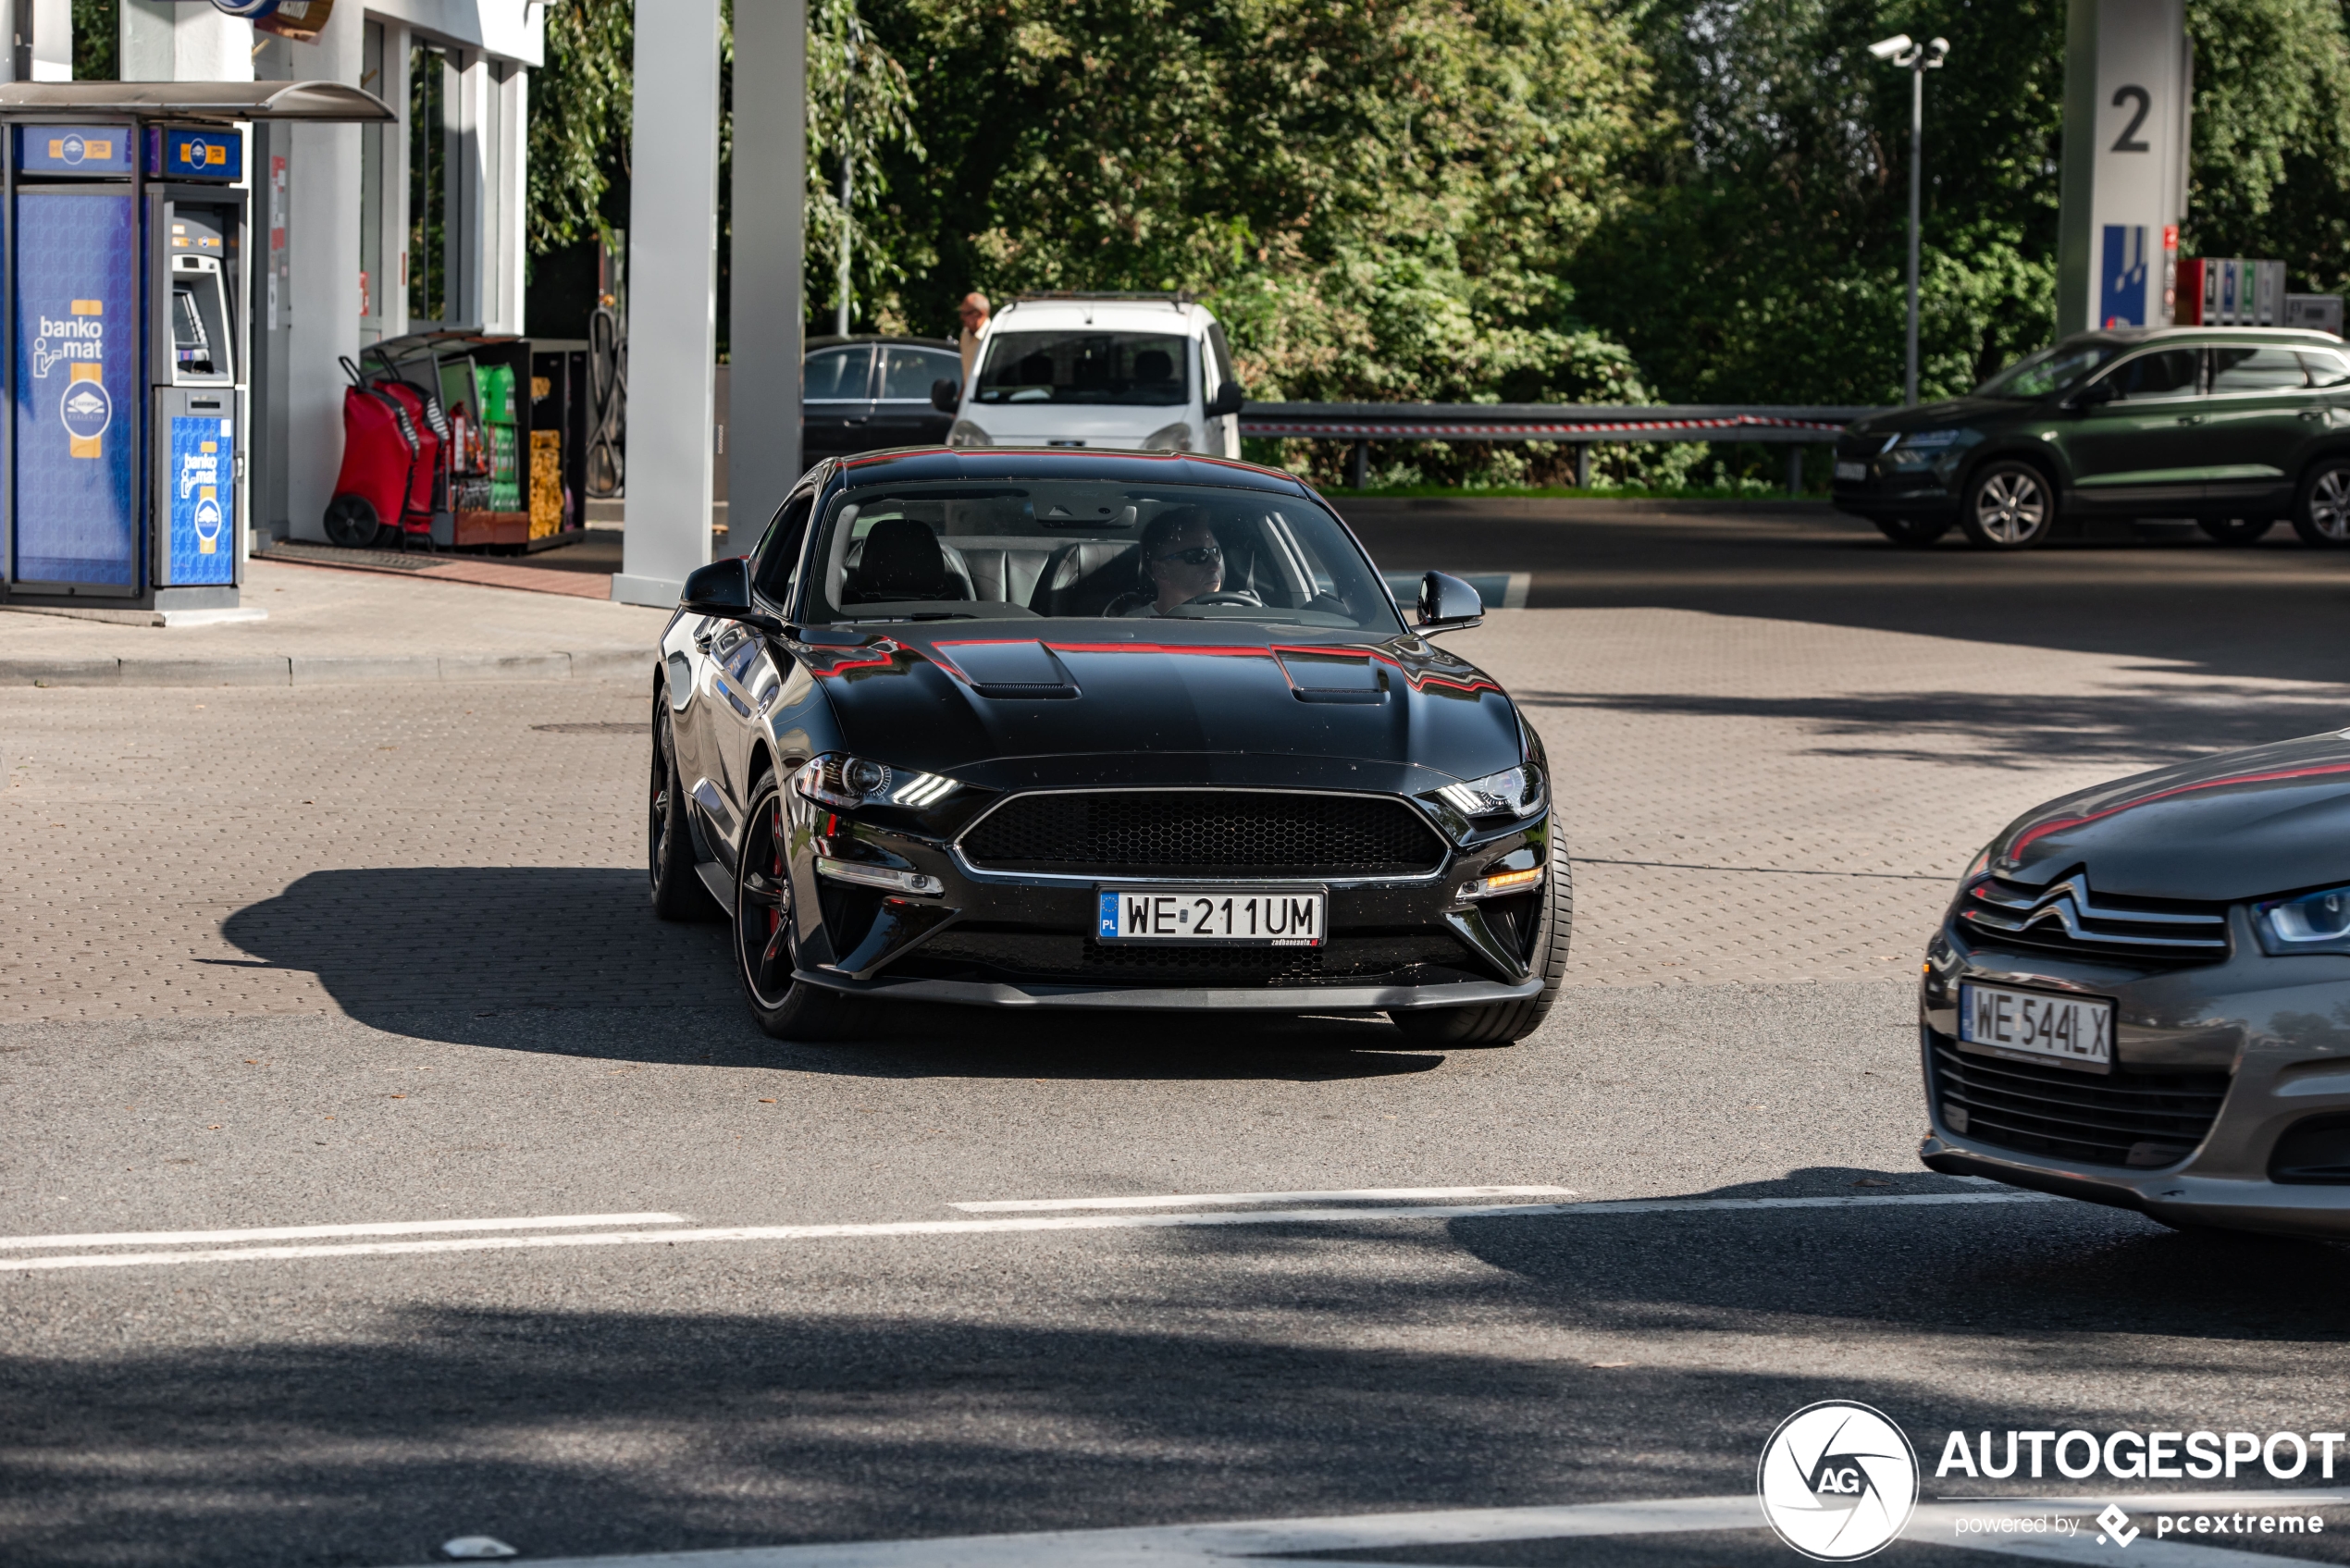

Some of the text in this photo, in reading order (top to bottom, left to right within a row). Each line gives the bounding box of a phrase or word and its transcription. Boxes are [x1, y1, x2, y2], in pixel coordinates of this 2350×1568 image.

[2110, 85, 2151, 153] 2
[40, 315, 103, 339] banko
[63, 339, 103, 359] mat
[185, 452, 217, 470] banko
[196, 469, 217, 484] mat
[1102, 920, 1116, 931] PL
[1127, 896, 1314, 935] WE 211UM
[1977, 991, 2109, 1056] WE 544LX
